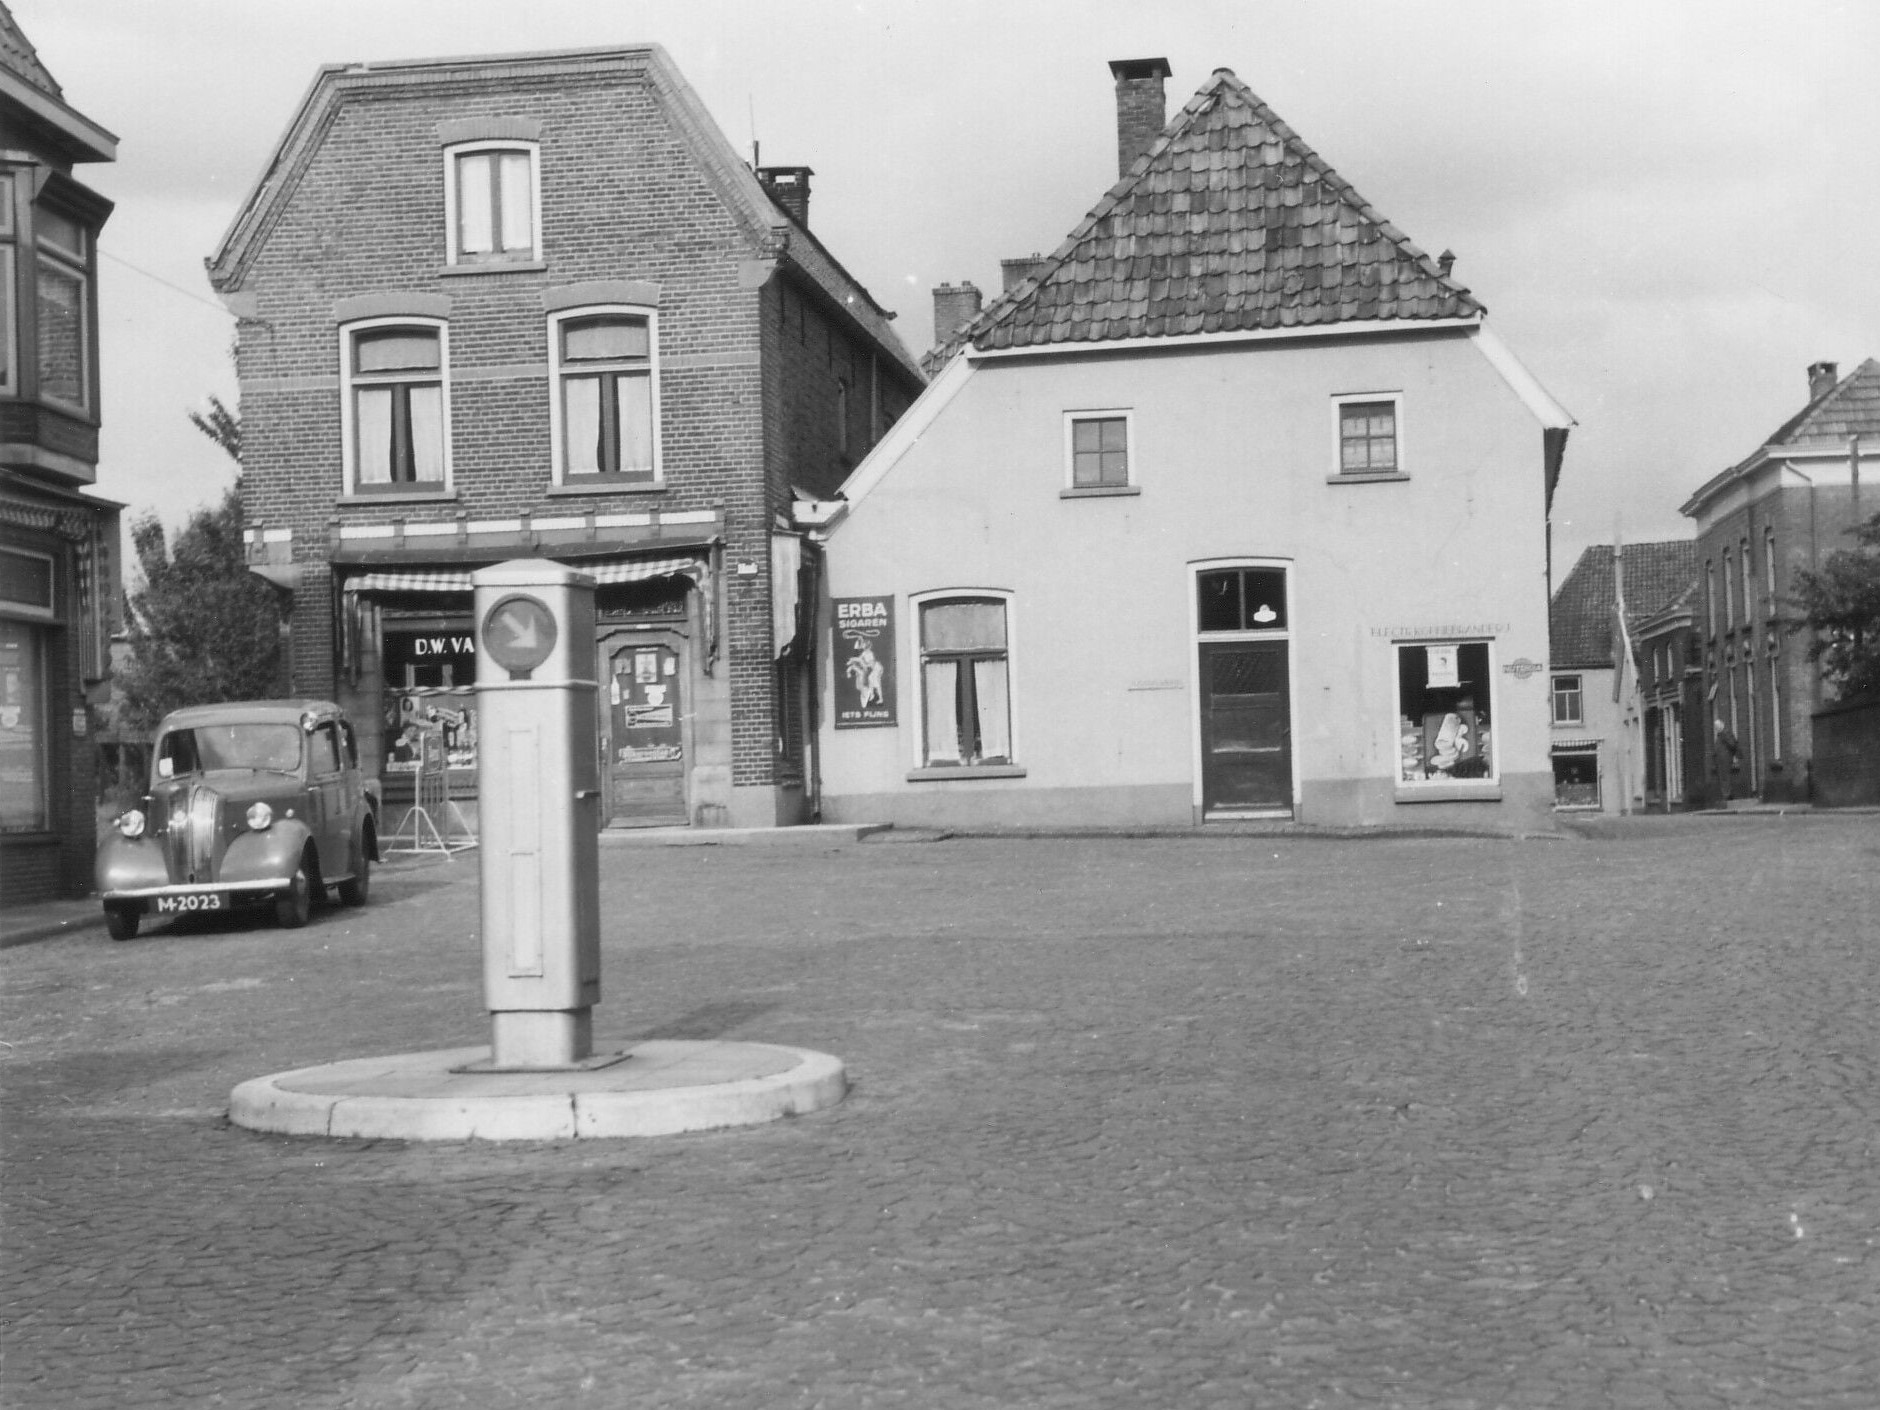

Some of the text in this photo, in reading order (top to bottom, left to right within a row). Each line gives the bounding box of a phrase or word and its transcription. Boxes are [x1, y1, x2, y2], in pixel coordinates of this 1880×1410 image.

[838, 602, 887, 619] ERBA
[839, 618, 887, 629] SIGAREN
[415, 638, 447, 655] D.W.
[157, 894, 221, 912] M-2023
